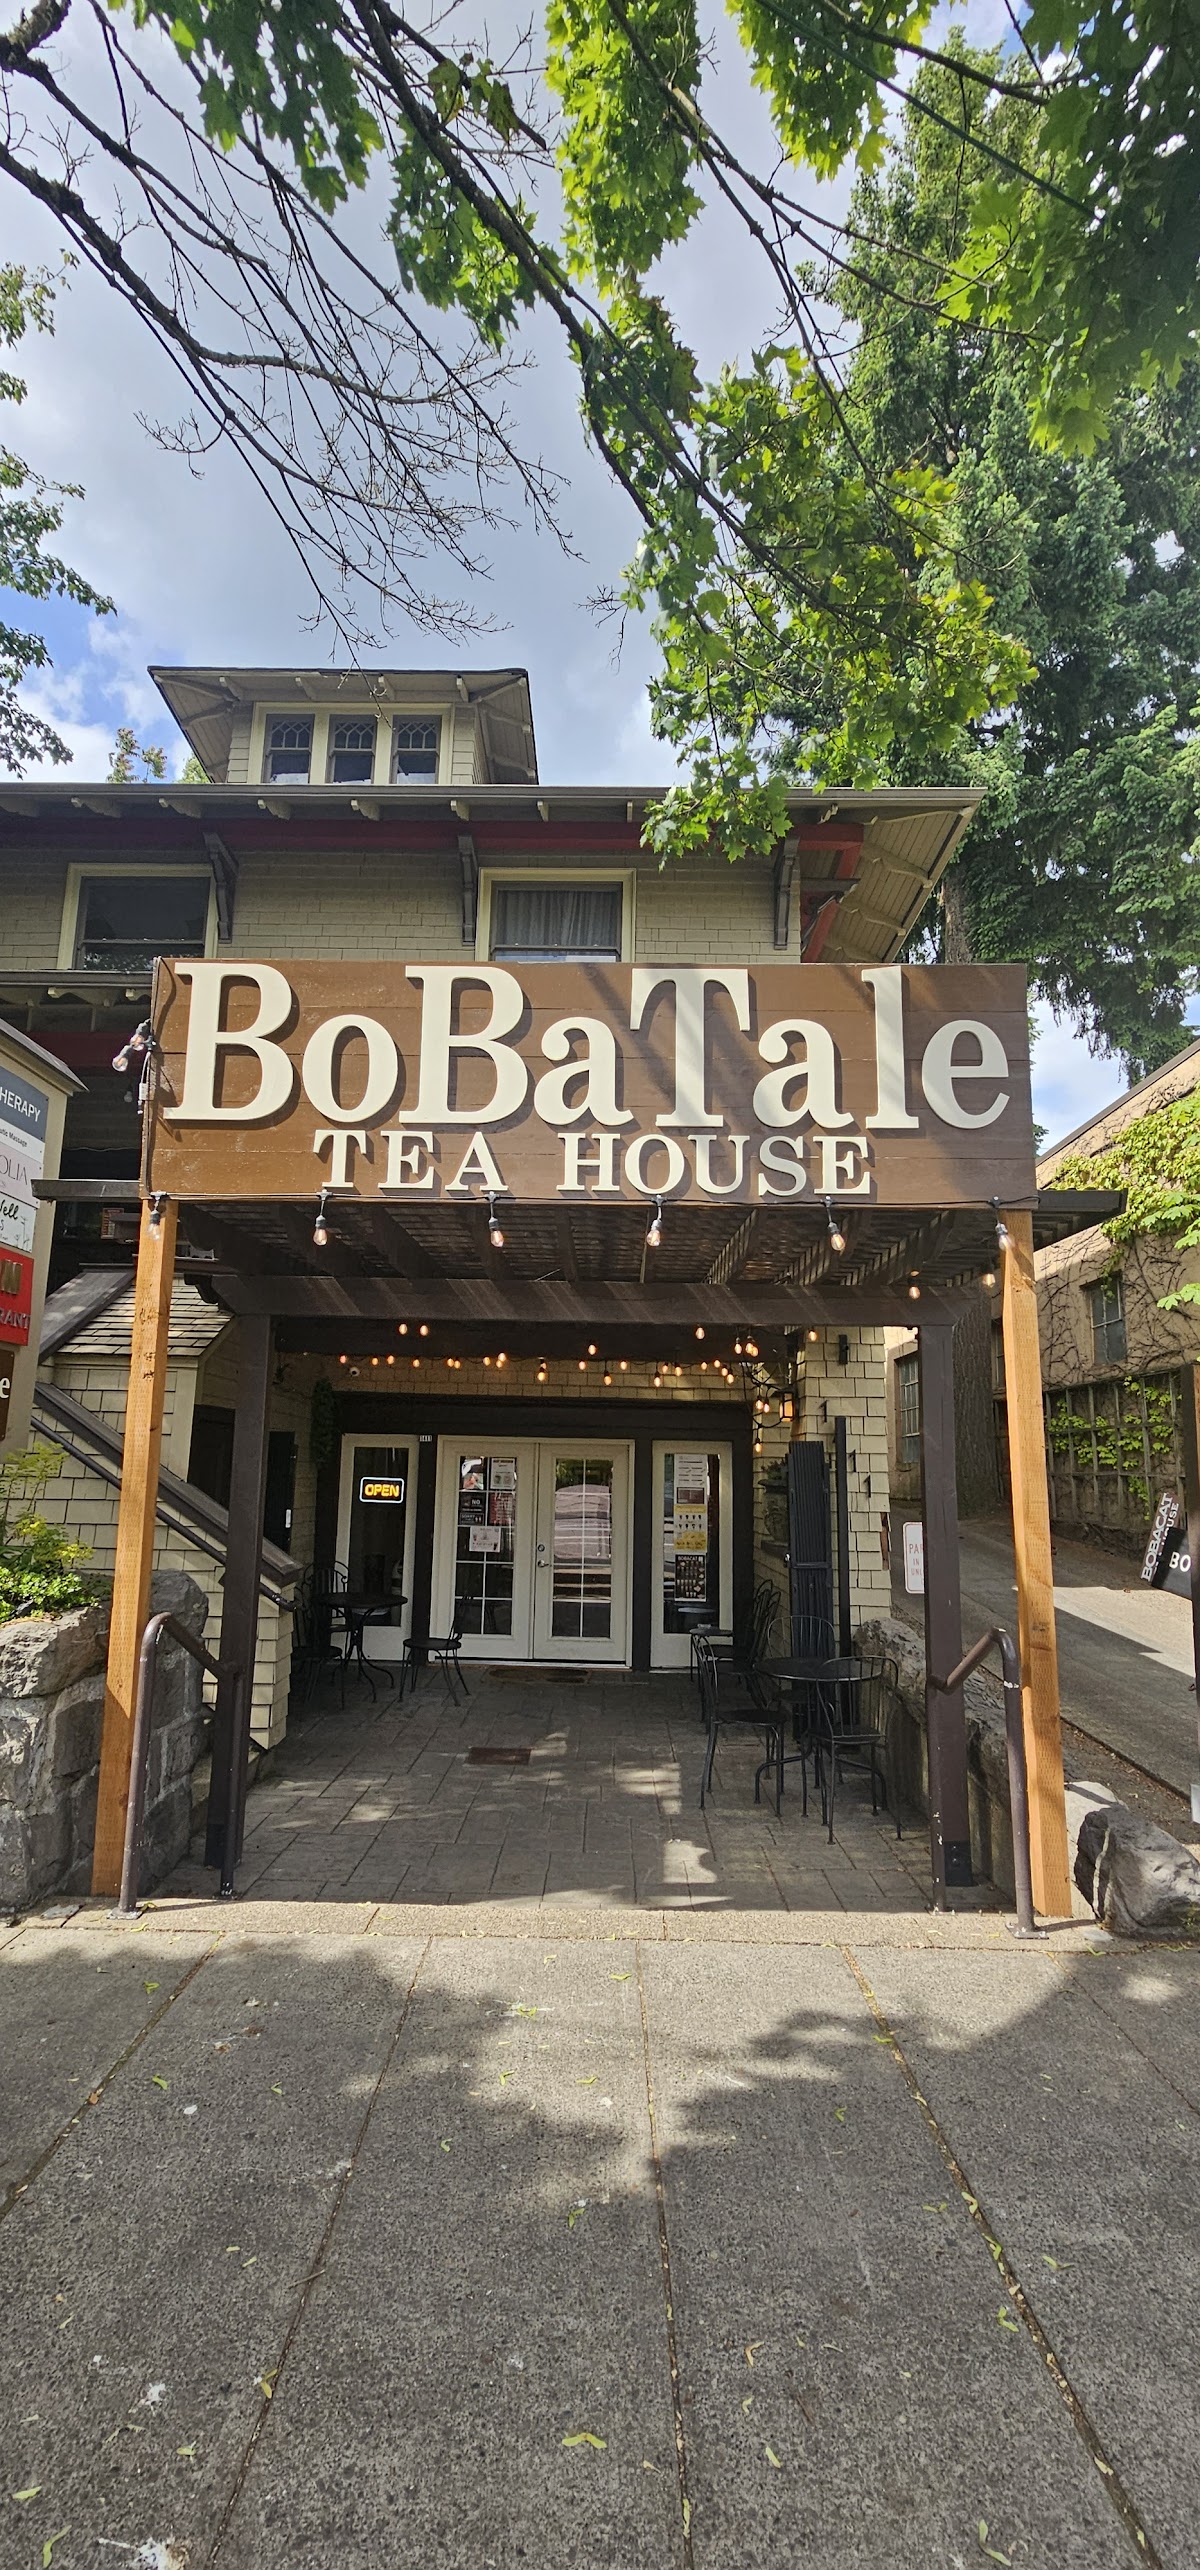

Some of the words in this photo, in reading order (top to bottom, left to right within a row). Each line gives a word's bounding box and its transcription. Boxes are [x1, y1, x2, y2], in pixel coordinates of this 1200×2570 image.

[163, 962, 1010, 1130] BoBaTale
[0, 1086, 41, 1122] HERAPY
[313, 1129, 508, 1192] TEA
[556, 1132, 872, 1197] HOUSE
[364, 1483, 400, 1497] OPEN
[1140, 1492, 1174, 1582] BOBACAT
